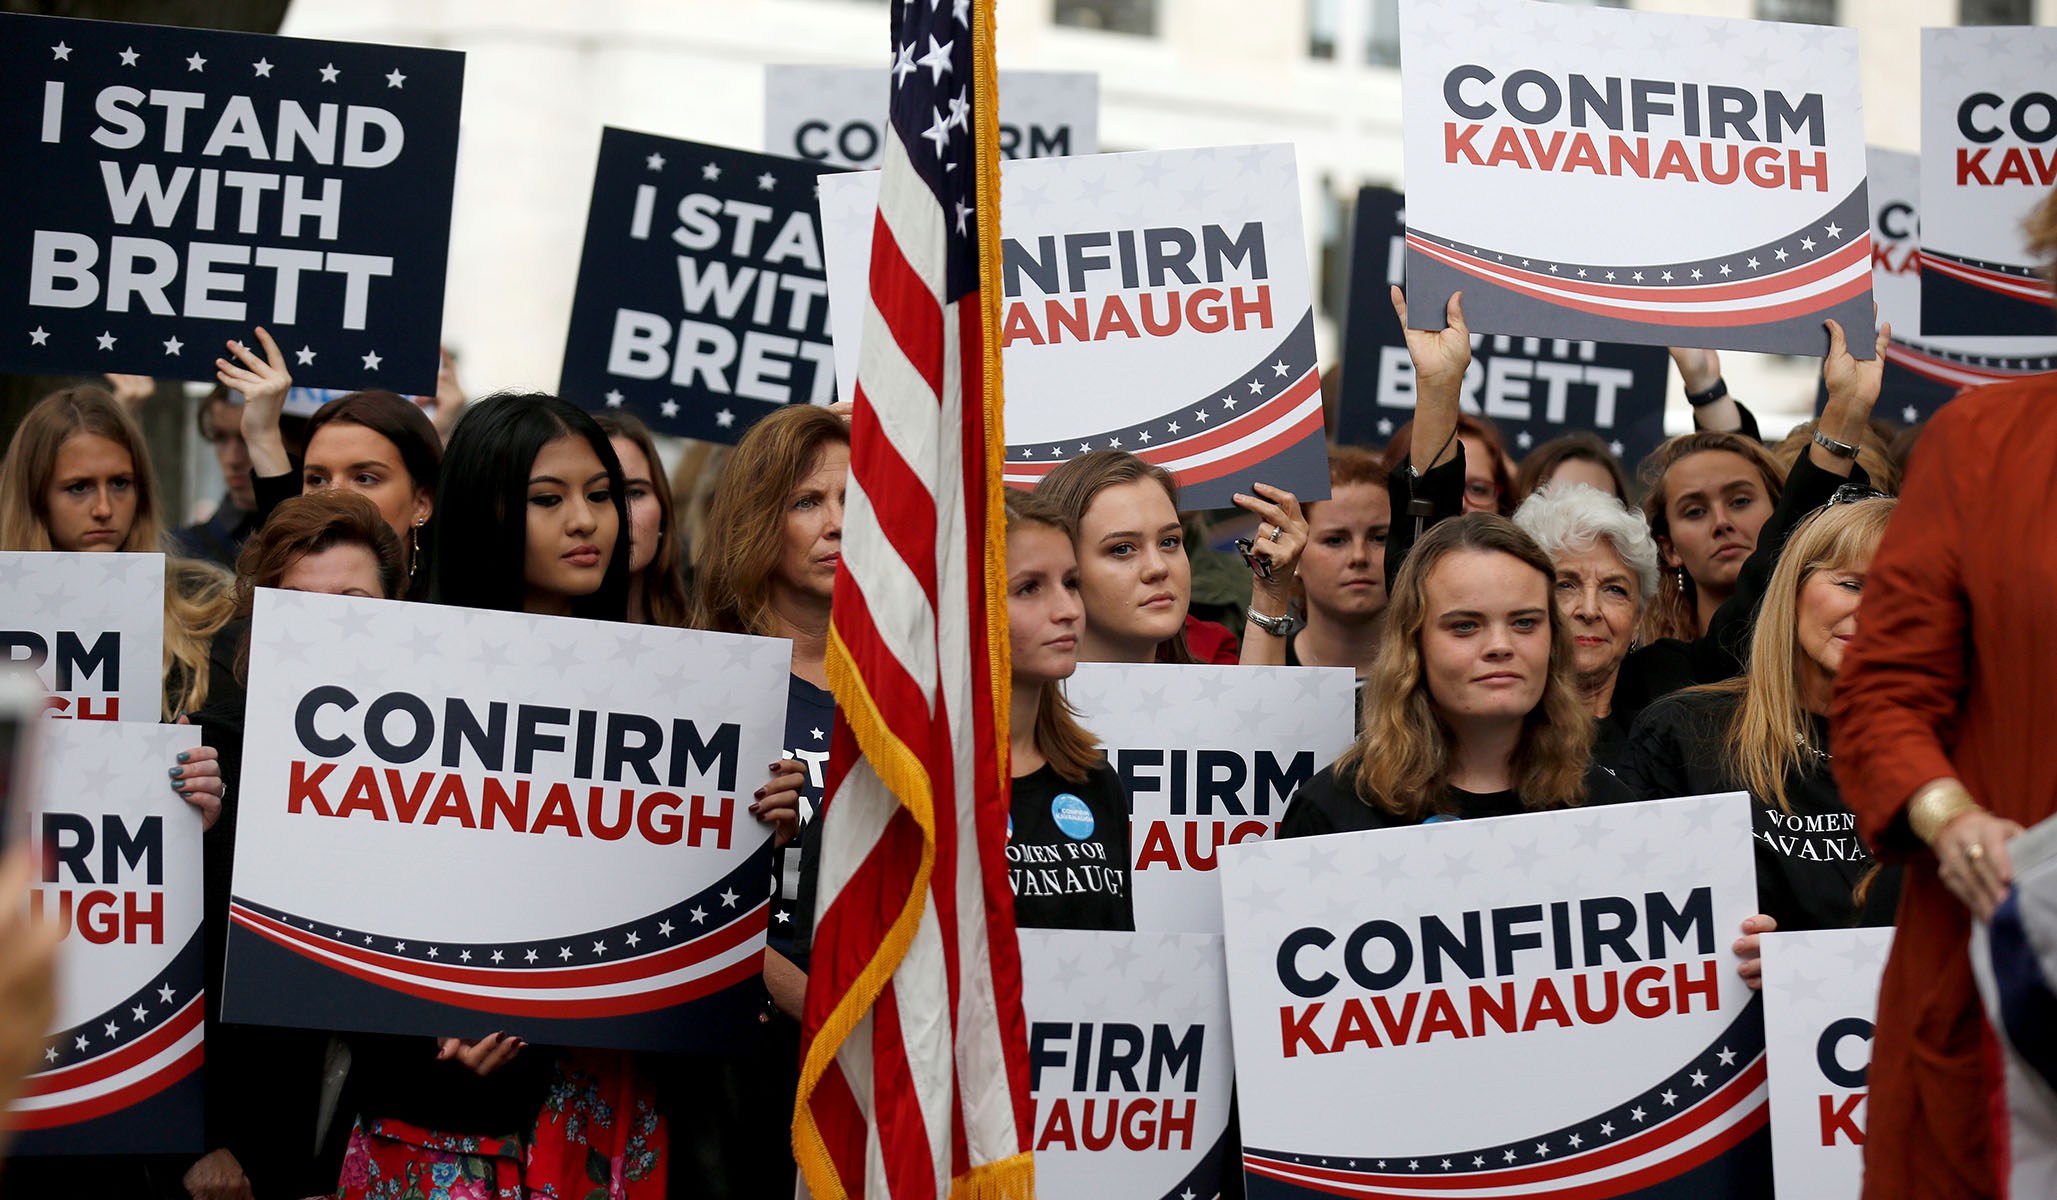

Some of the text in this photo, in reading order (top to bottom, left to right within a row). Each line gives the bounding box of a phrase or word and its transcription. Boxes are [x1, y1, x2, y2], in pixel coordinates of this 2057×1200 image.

[41, 81, 405, 169] I STAND
[1443, 63, 1827, 148] CONFIRM
[1443, 121, 1829, 193] KAVANAUGH
[100, 160, 342, 241] WITH
[630, 183, 658, 241] I
[28, 230, 394, 331] BRETT
[676, 254, 833, 339] WIT
[294, 684, 742, 793] CONFIRM
[287, 760, 736, 851] KAVANAUGH
[1097, 748, 1315, 816] FIRM
[1765, 808, 1857, 833] WOMEN
[27, 812, 164, 885] RM
[1275, 885, 1717, 998] CONFIRM
[1278, 959, 1720, 1058] KAVANAUGH
[1031, 1097, 1197, 1152] AUGH
